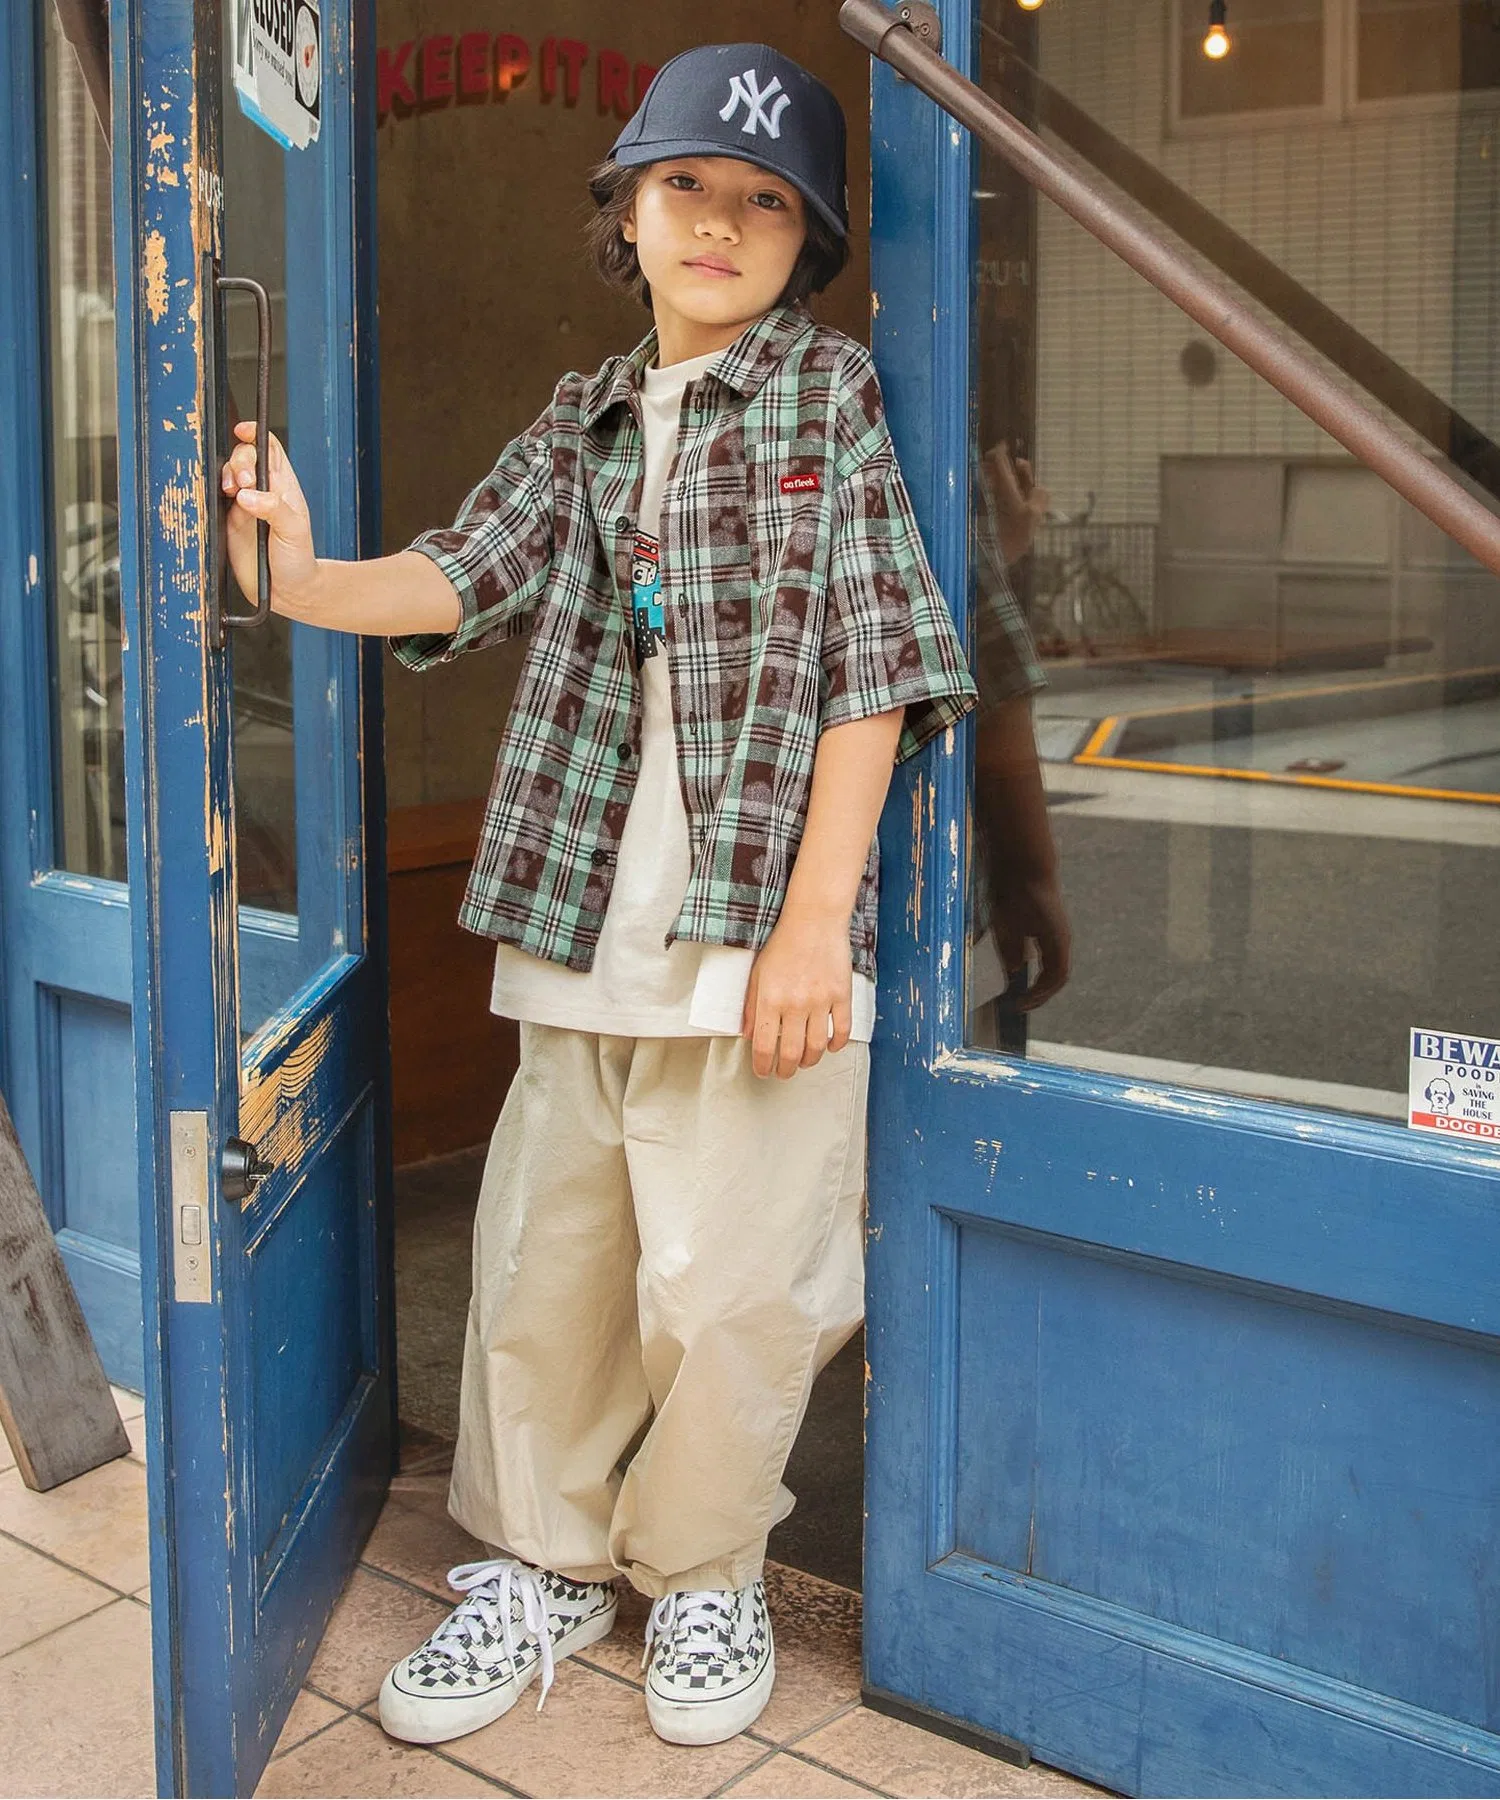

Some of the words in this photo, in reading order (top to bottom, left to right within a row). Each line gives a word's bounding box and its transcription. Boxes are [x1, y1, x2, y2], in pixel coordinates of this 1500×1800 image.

[377, 31, 532, 122] KEEP
[540, 35, 590, 106] IT
[718, 68, 792, 140] NY
[199, 166, 224, 211] PUSH
[1420, 1034, 1500, 1068] BEWA
[1445, 1064, 1500, 1083] POOD
[1462, 1088, 1495, 1101] SAVING
[1470, 1099, 1487, 1109] THE
[1463, 1108, 1493, 1120] HOUSE
[1436, 1117, 1477, 1134] DOG
